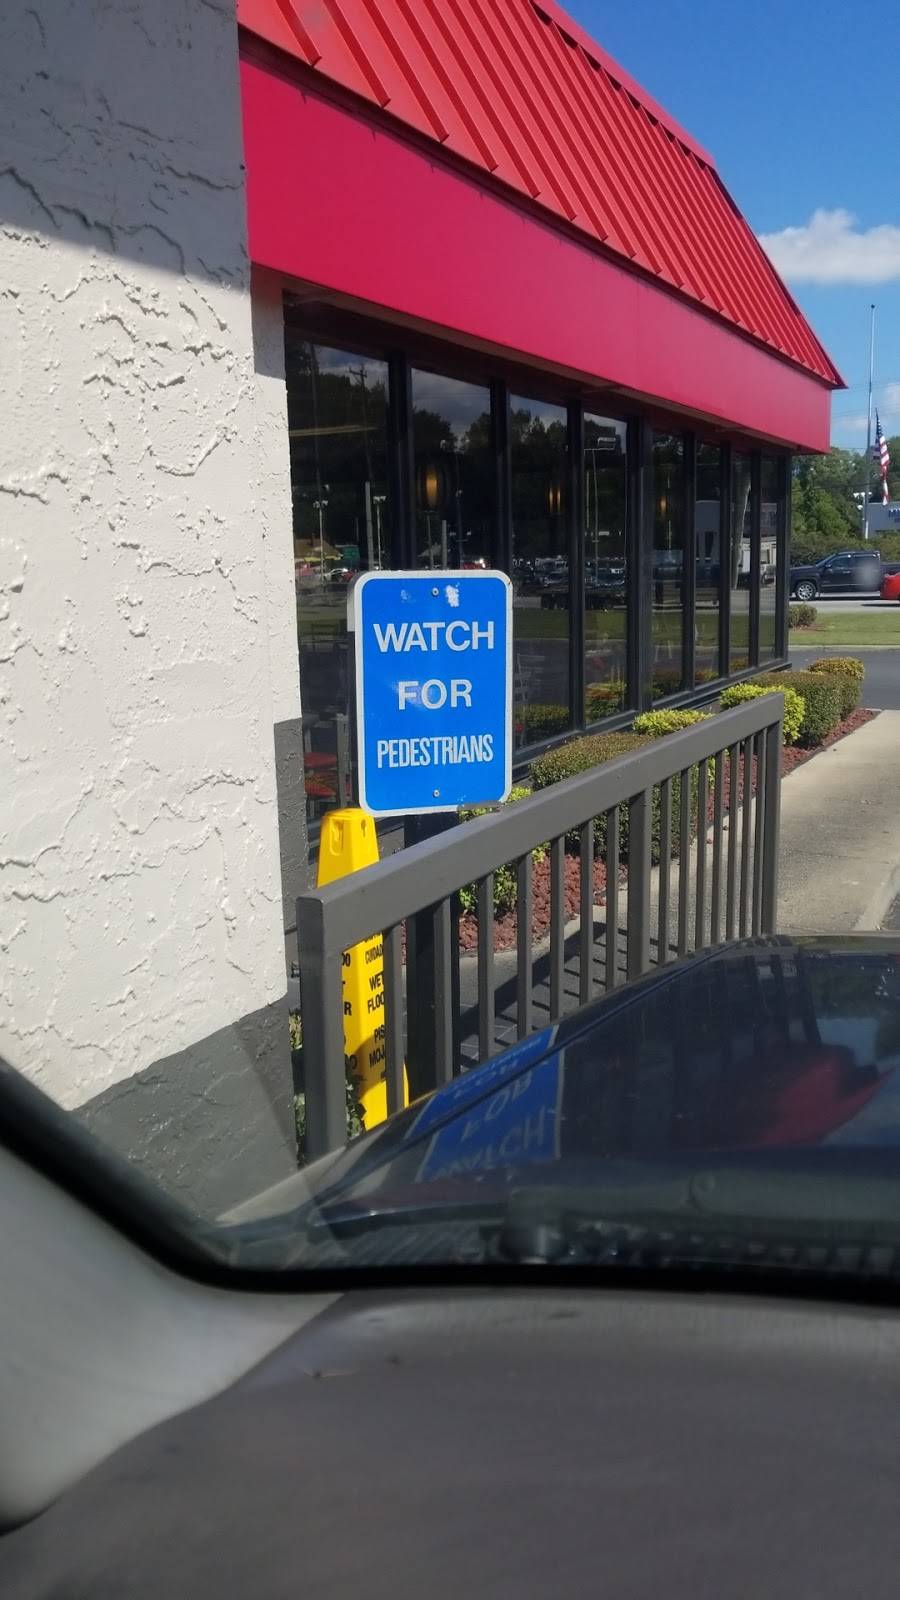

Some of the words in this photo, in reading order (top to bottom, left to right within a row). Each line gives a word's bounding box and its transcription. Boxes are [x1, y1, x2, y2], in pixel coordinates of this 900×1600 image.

[373, 621, 495, 653] WATCH
[398, 678, 473, 710] FOR
[376, 734, 493, 769] PEDESTRIANS
[367, 991, 385, 1014] FLOO
[374, 1024, 385, 1043] PIS
[369, 1045, 385, 1068] MOJ
